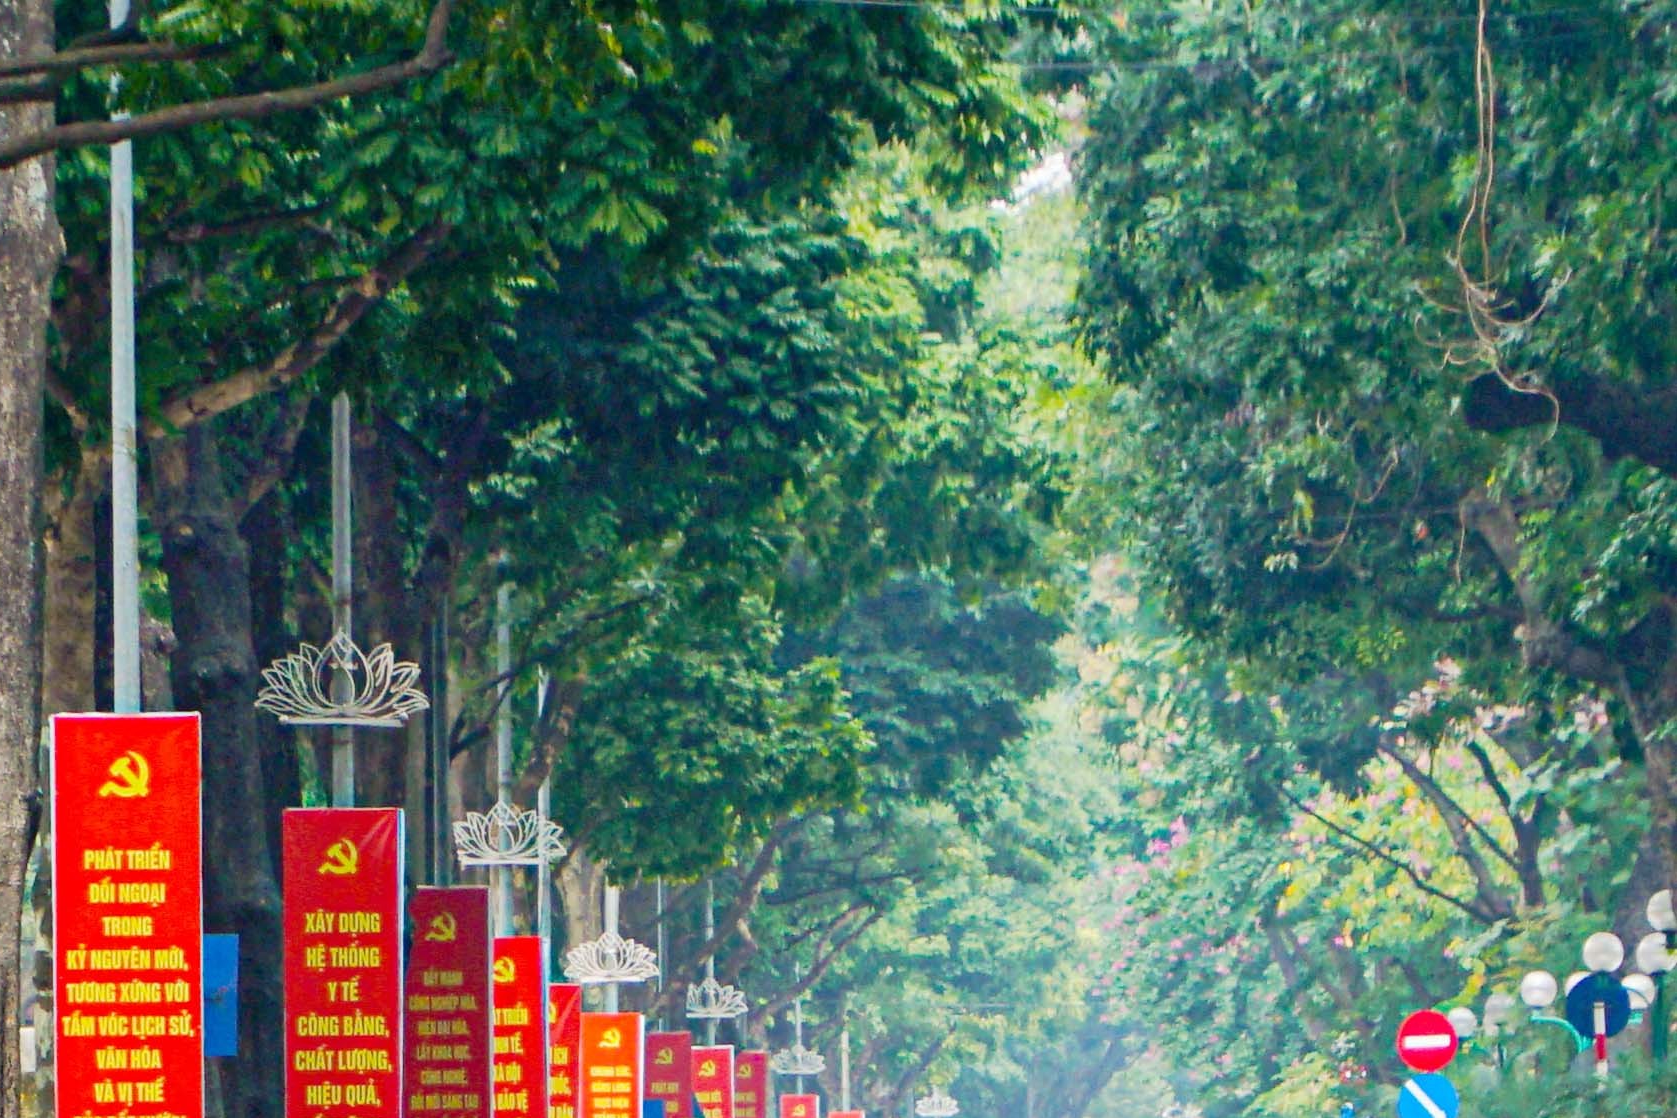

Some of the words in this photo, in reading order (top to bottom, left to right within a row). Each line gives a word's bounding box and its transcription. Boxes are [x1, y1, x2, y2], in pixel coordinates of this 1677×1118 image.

[84, 846, 123, 870] PHÁT
[126, 841, 171, 869] TRIỂN
[119, 883, 166, 907] NGOẠI
[103, 916, 153, 936] TRONG
[305, 909, 334, 933] XÂY
[339, 911, 381, 937] DỰNG
[91, 946, 151, 970] NGUYÊN
[154, 945, 189, 971] MỚI,
[306, 944, 326, 972] HỆ
[330, 940, 380, 968] THỐNG
[66, 981, 115, 1003] TƯƠNG
[120, 978, 161, 1002] XỨNG
[165, 979, 190, 1002] VỚI
[327, 982, 337, 1002] Y
[340, 976, 360, 1002] TẾ
[98, 1012, 128, 1036] VÓC
[132, 1016, 165, 1039] LỊCH
[297, 1012, 339, 1036] CÔNG
[343, 1009, 390, 1037] BẰNG,
[130, 1045, 161, 1068] HÓA
[295, 1044, 335, 1071] CHẤT
[338, 1048, 392, 1075] LƯỢNG,
[94, 1079, 115, 1102] VÀ
[118, 1082, 133, 1106] VỊ
[137, 1078, 164, 1102] THẾ
[307, 1082, 341, 1110] HIỆU
[346, 1078, 381, 1107] QUẢ,
